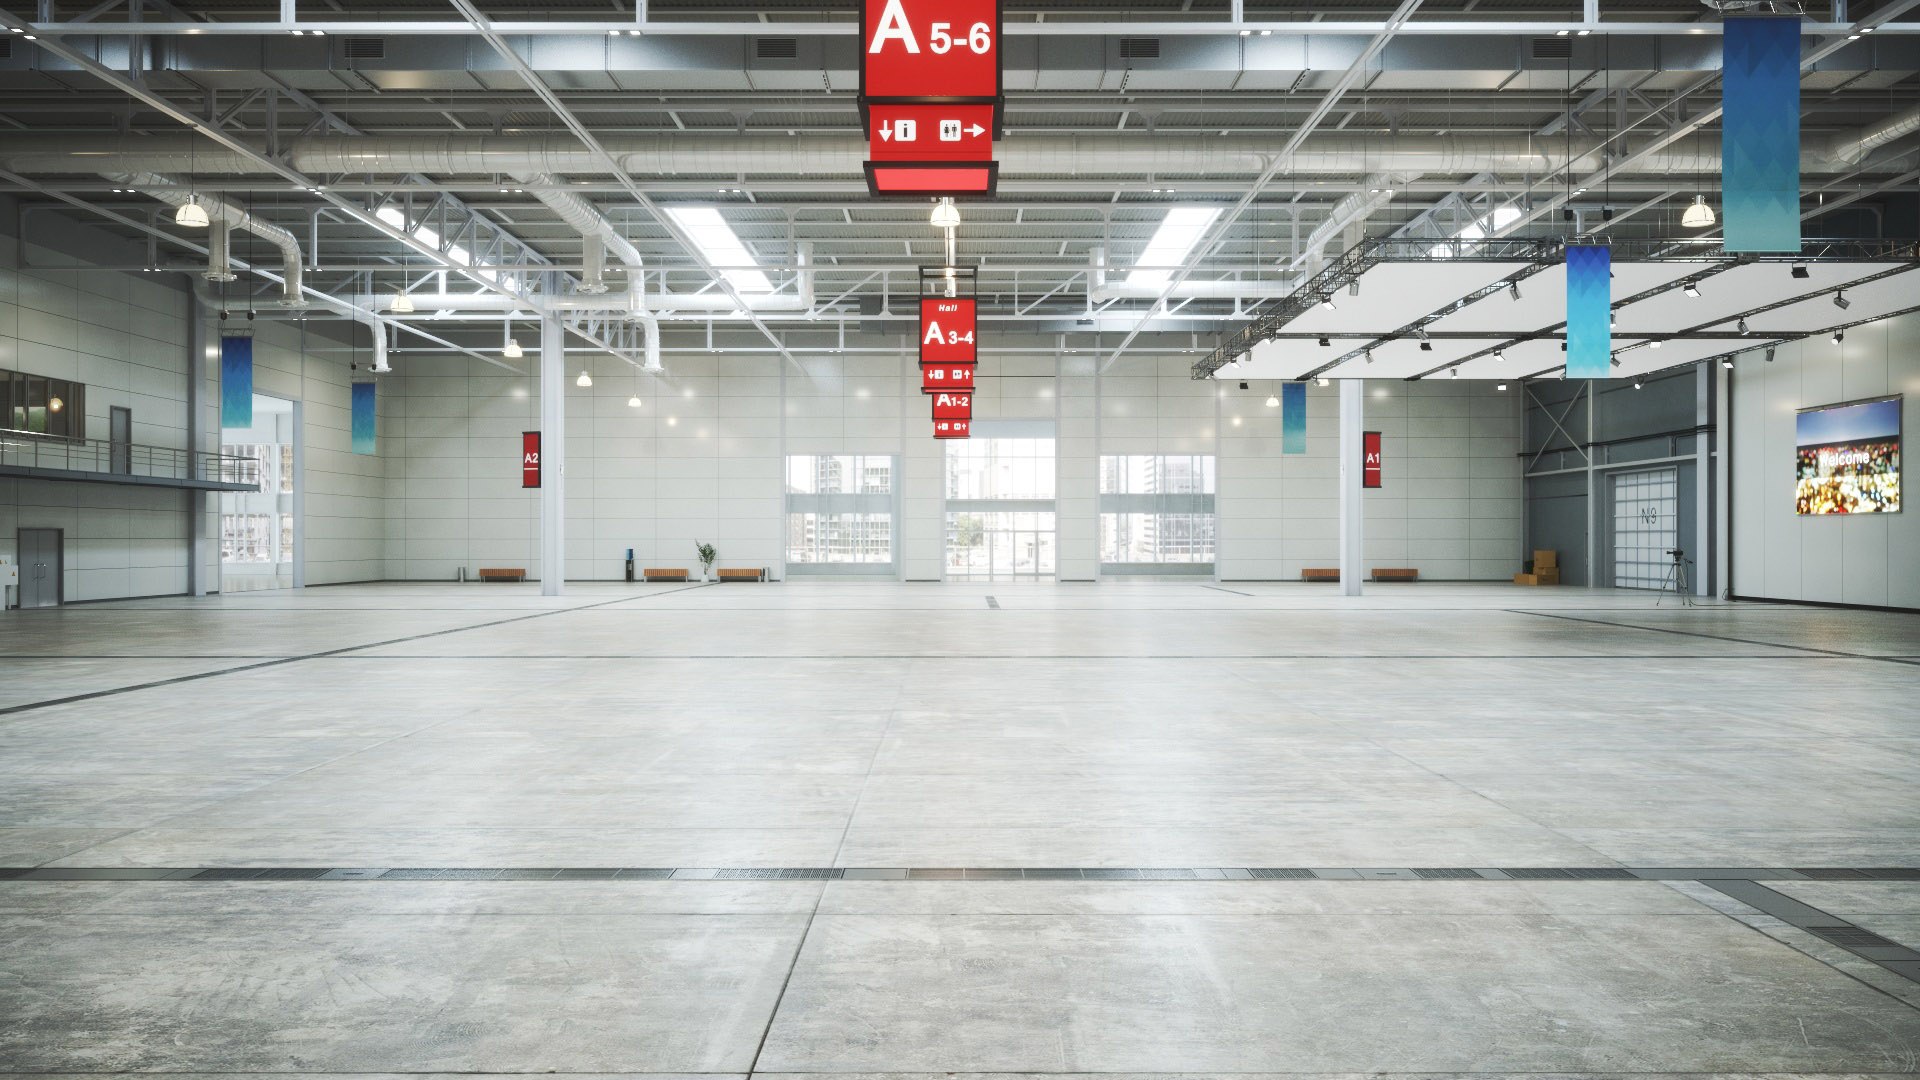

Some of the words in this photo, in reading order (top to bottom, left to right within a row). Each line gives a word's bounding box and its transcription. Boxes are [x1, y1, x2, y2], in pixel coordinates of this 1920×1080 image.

[869, 0, 921, 54] A
[929, 22, 991, 55] 5-6
[938, 304, 958, 312] Hall
[923, 321, 946, 345] A
[948, 330, 974, 345] 3-4
[524, 452, 539, 464] A2
[1366, 452, 1380, 464] A1
[1819, 452, 1870, 467] Welcome
